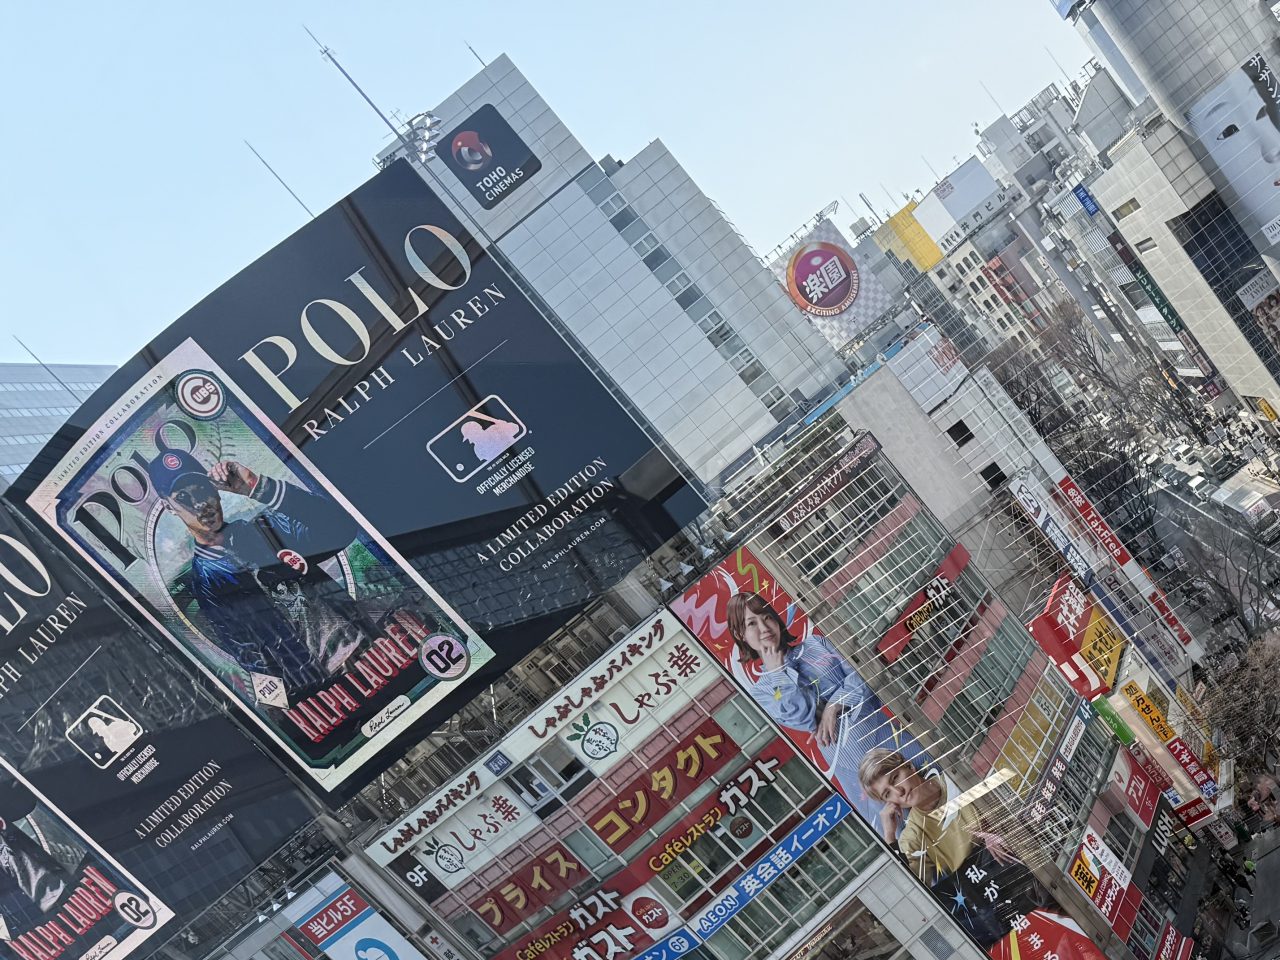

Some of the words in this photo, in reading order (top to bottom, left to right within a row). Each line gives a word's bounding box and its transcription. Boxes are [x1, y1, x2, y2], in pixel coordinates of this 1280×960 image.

[476, 165, 507, 192] TOHO
[485, 168, 524, 201] CINEMAS
[960, 191, 1006, 231] 井門ビル
[802, 255, 847, 304] 楽園
[807, 304, 840, 316] EXCITING
[841, 269, 856, 312] AMUSEMENT
[238, 224, 472, 413] POLO
[302, 366, 396, 441] RALPH
[401, 283, 507, 366] LAUREN
[79, 429, 105, 456] EDITION
[105, 373, 164, 429] COLLABORATION
[476, 464, 509, 495] OFFICIALLY
[506, 446, 535, 474] LICENSED
[492, 461, 535, 496] MERCHANDISE
[476, 551, 489, 565] A
[486, 503, 548, 555] LIMITED
[546, 456, 608, 508] EDITION
[499, 477, 615, 572] COLLABORATION
[1086, 510, 1121, 558] TaxFree
[541, 517, 607, 570] RALPHLAUREN.COM
[924, 576, 952, 611] ガスト
[1057, 580, 1088, 641] スギ薬局
[18, 591, 88, 665] LAUREN
[283, 683, 361, 743] RALPH
[345, 608, 432, 698] LAUREN
[426, 639, 465, 674] 02
[528, 617, 666, 739] しゃぶしゃぶバイキング
[258, 680, 279, 699] POLO
[609, 642, 701, 725] しゃぶ葉
[1125, 684, 1162, 726] 処方せん
[1081, 698, 1093, 720] 4F
[1169, 741, 1208, 784] スギ薬局
[134, 827, 145, 840] A
[142, 795, 182, 833] LIMITED
[177, 759, 222, 801] EDITION
[155, 778, 233, 848] COLLABORATION
[381, 770, 481, 854] しゃぶしゃぶバイキング
[1128, 774, 1146, 806] アコム
[191, 813, 235, 851] RALPHLAUREN.COM
[450, 795, 521, 852] しゃぶ葉
[479, 848, 582, 927] プライス
[594, 732, 724, 845] コンタクト
[648, 806, 723, 872] Caféレストラン
[718, 757, 780, 815] ガスト
[1152, 808, 1174, 856] LUSH
[405, 864, 429, 888] 9F
[662, 863, 682, 880] OPEN
[700, 895, 740, 934] AEON
[739, 801, 842, 897] 英会話イーオン
[57, 865, 119, 935] LAUREN
[120, 896, 150, 923] 02
[308, 894, 358, 939] 当ビル5F
[568, 888, 623, 931] ガスト
[643, 905, 664, 924] ガスト
[671, 935, 686, 952] 6F
